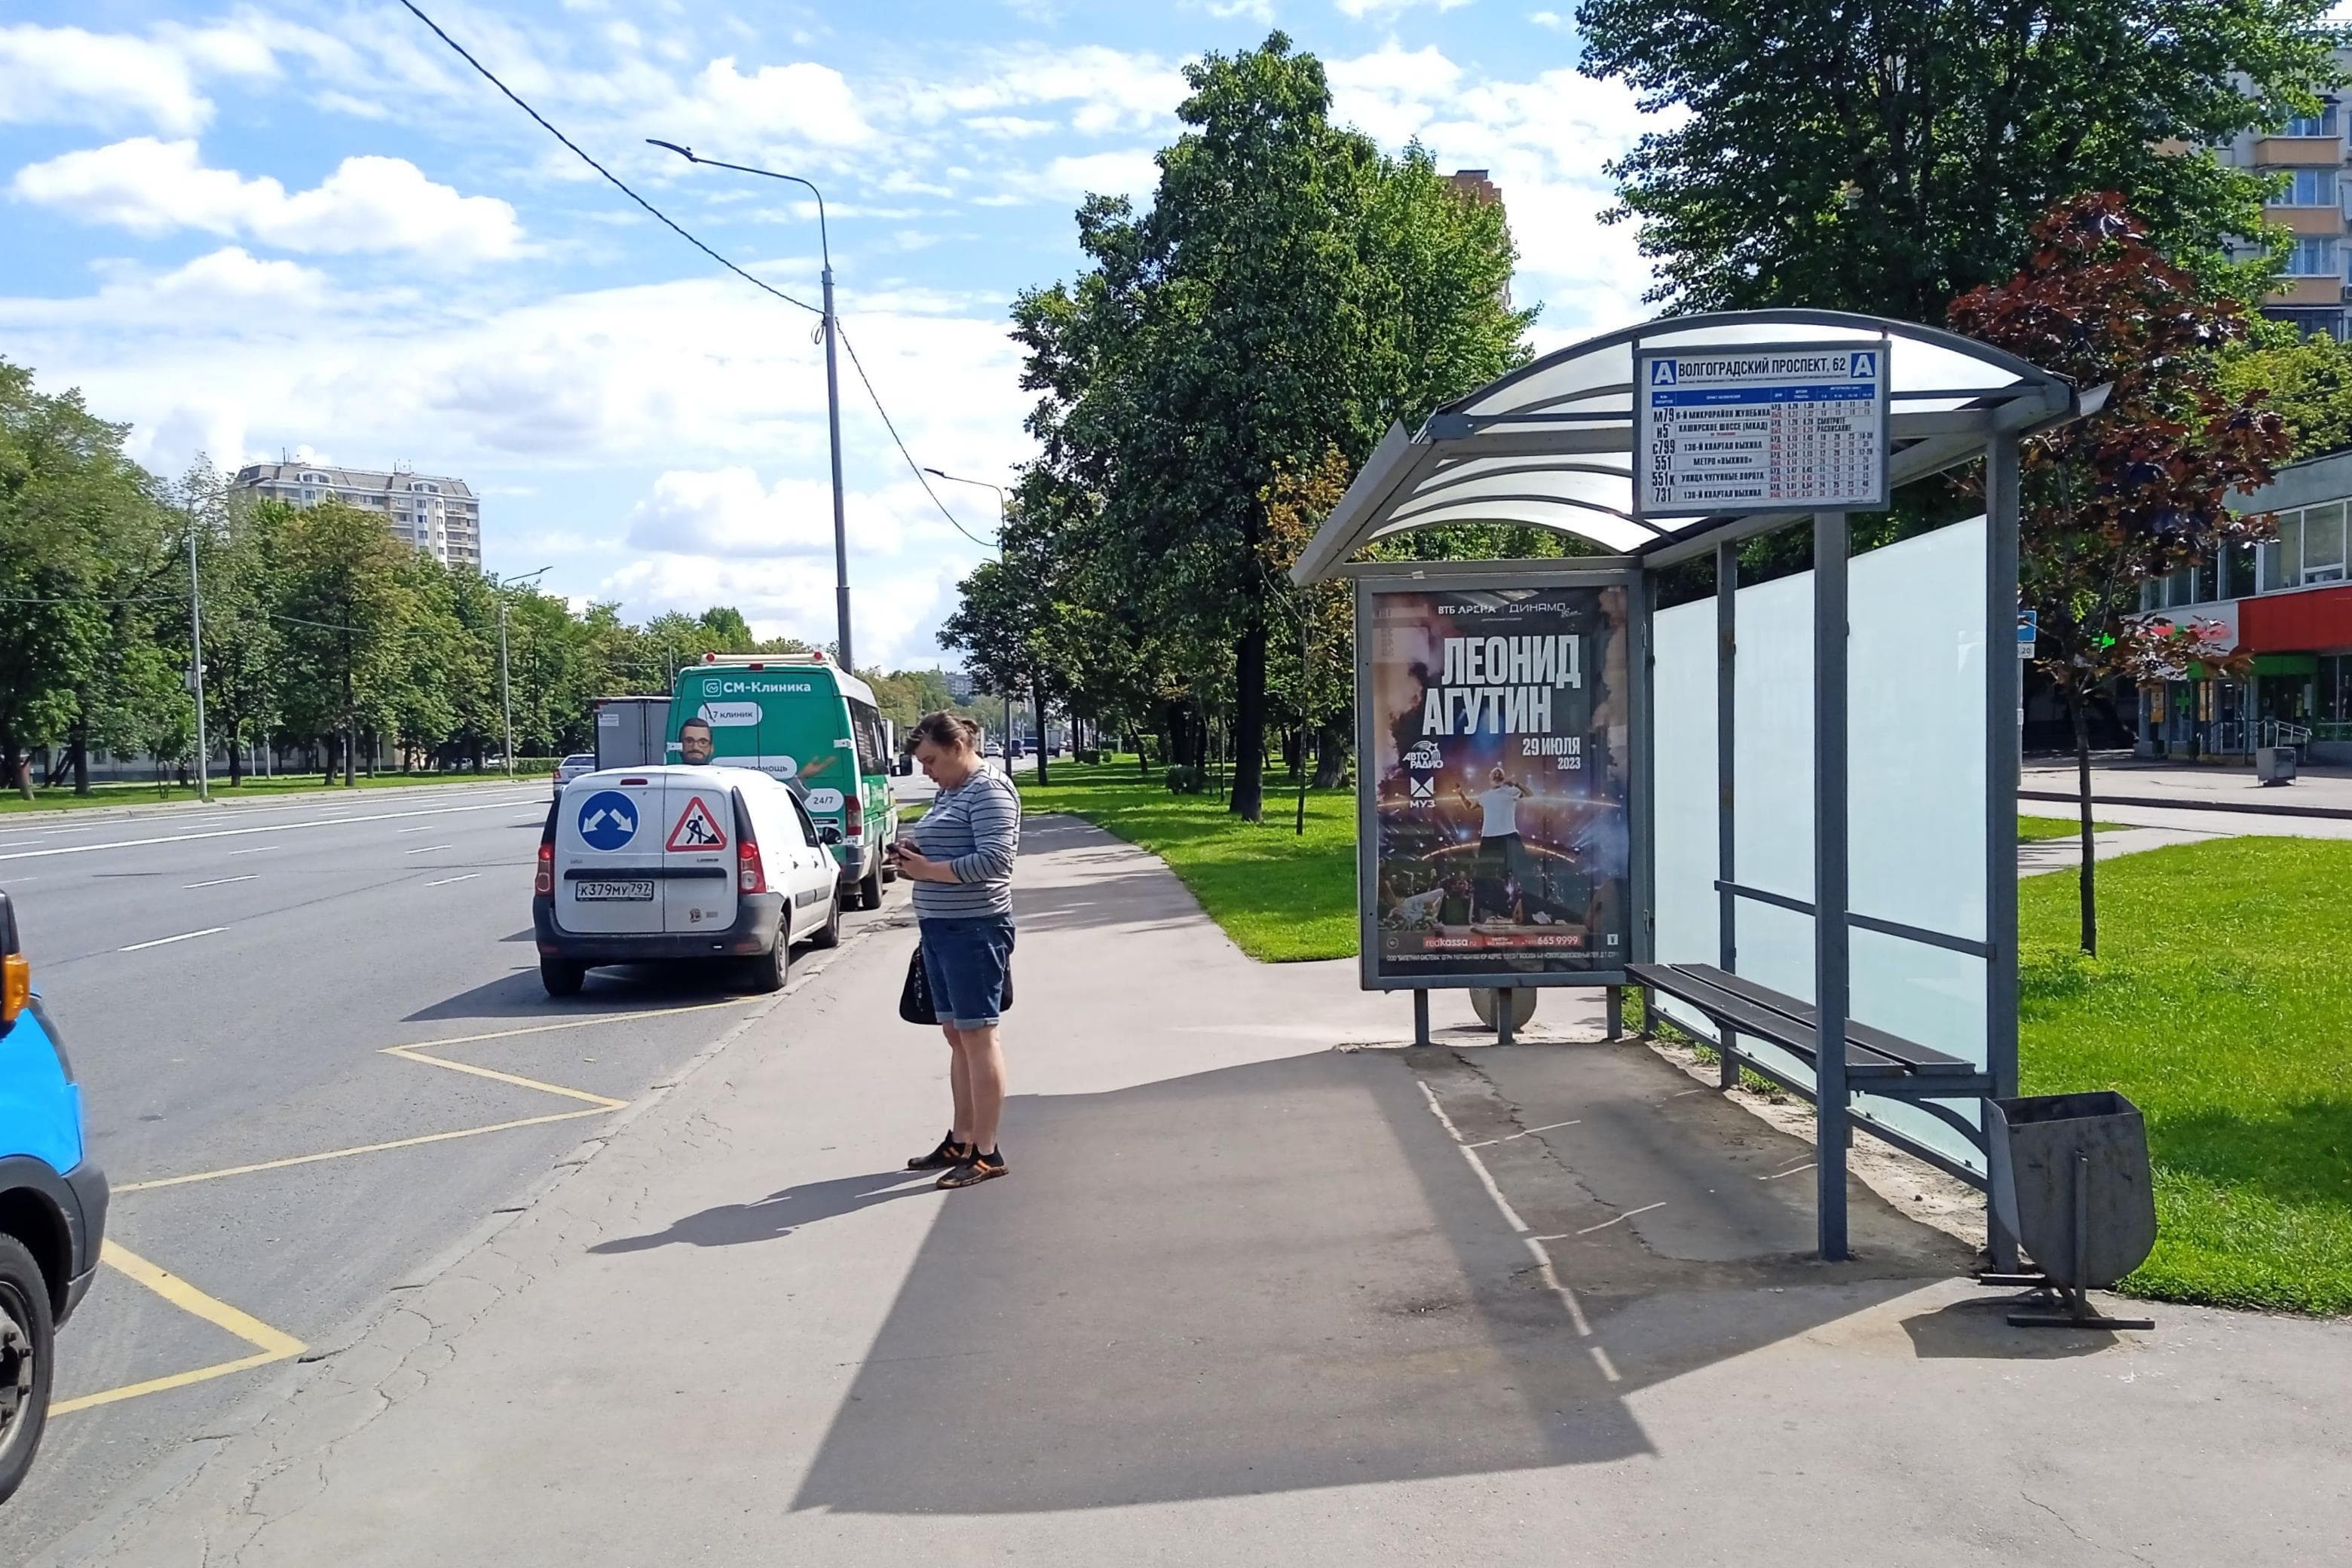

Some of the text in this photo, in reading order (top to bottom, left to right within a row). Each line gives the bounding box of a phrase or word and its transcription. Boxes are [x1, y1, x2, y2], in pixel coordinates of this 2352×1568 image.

[1679, 357, 1845, 377] ВОЛГОГРАДСКИЙ ПРОСПЕКТ, 62
[1655, 455, 1671, 470] 551
[1693, 458, 1716, 466] МЕТРО
[1655, 487, 1671, 502] 731
[1438, 605, 1496, 614] ВТБ АРЕНА
[1509, 603, 1566, 613] ДИНАМО
[1441, 635, 1581, 689] ЛЕОНИД
[724, 681, 812, 694] СМ-Клиника
[1422, 686, 1551, 736] АГУТИН
[1523, 737, 1580, 756] 29 ИЮЛЯ
[1402, 752, 1429, 761] АВТО
[1410, 760, 1444, 769] РАДИО
[1557, 757, 1581, 770] 2023
[813, 796, 834, 805] 24/7
[1410, 799, 1436, 808] МУЗ
[630, 883, 649, 893] 797
[1537, 936, 1554, 945] 665
[1556, 936, 1579, 945] 9999
